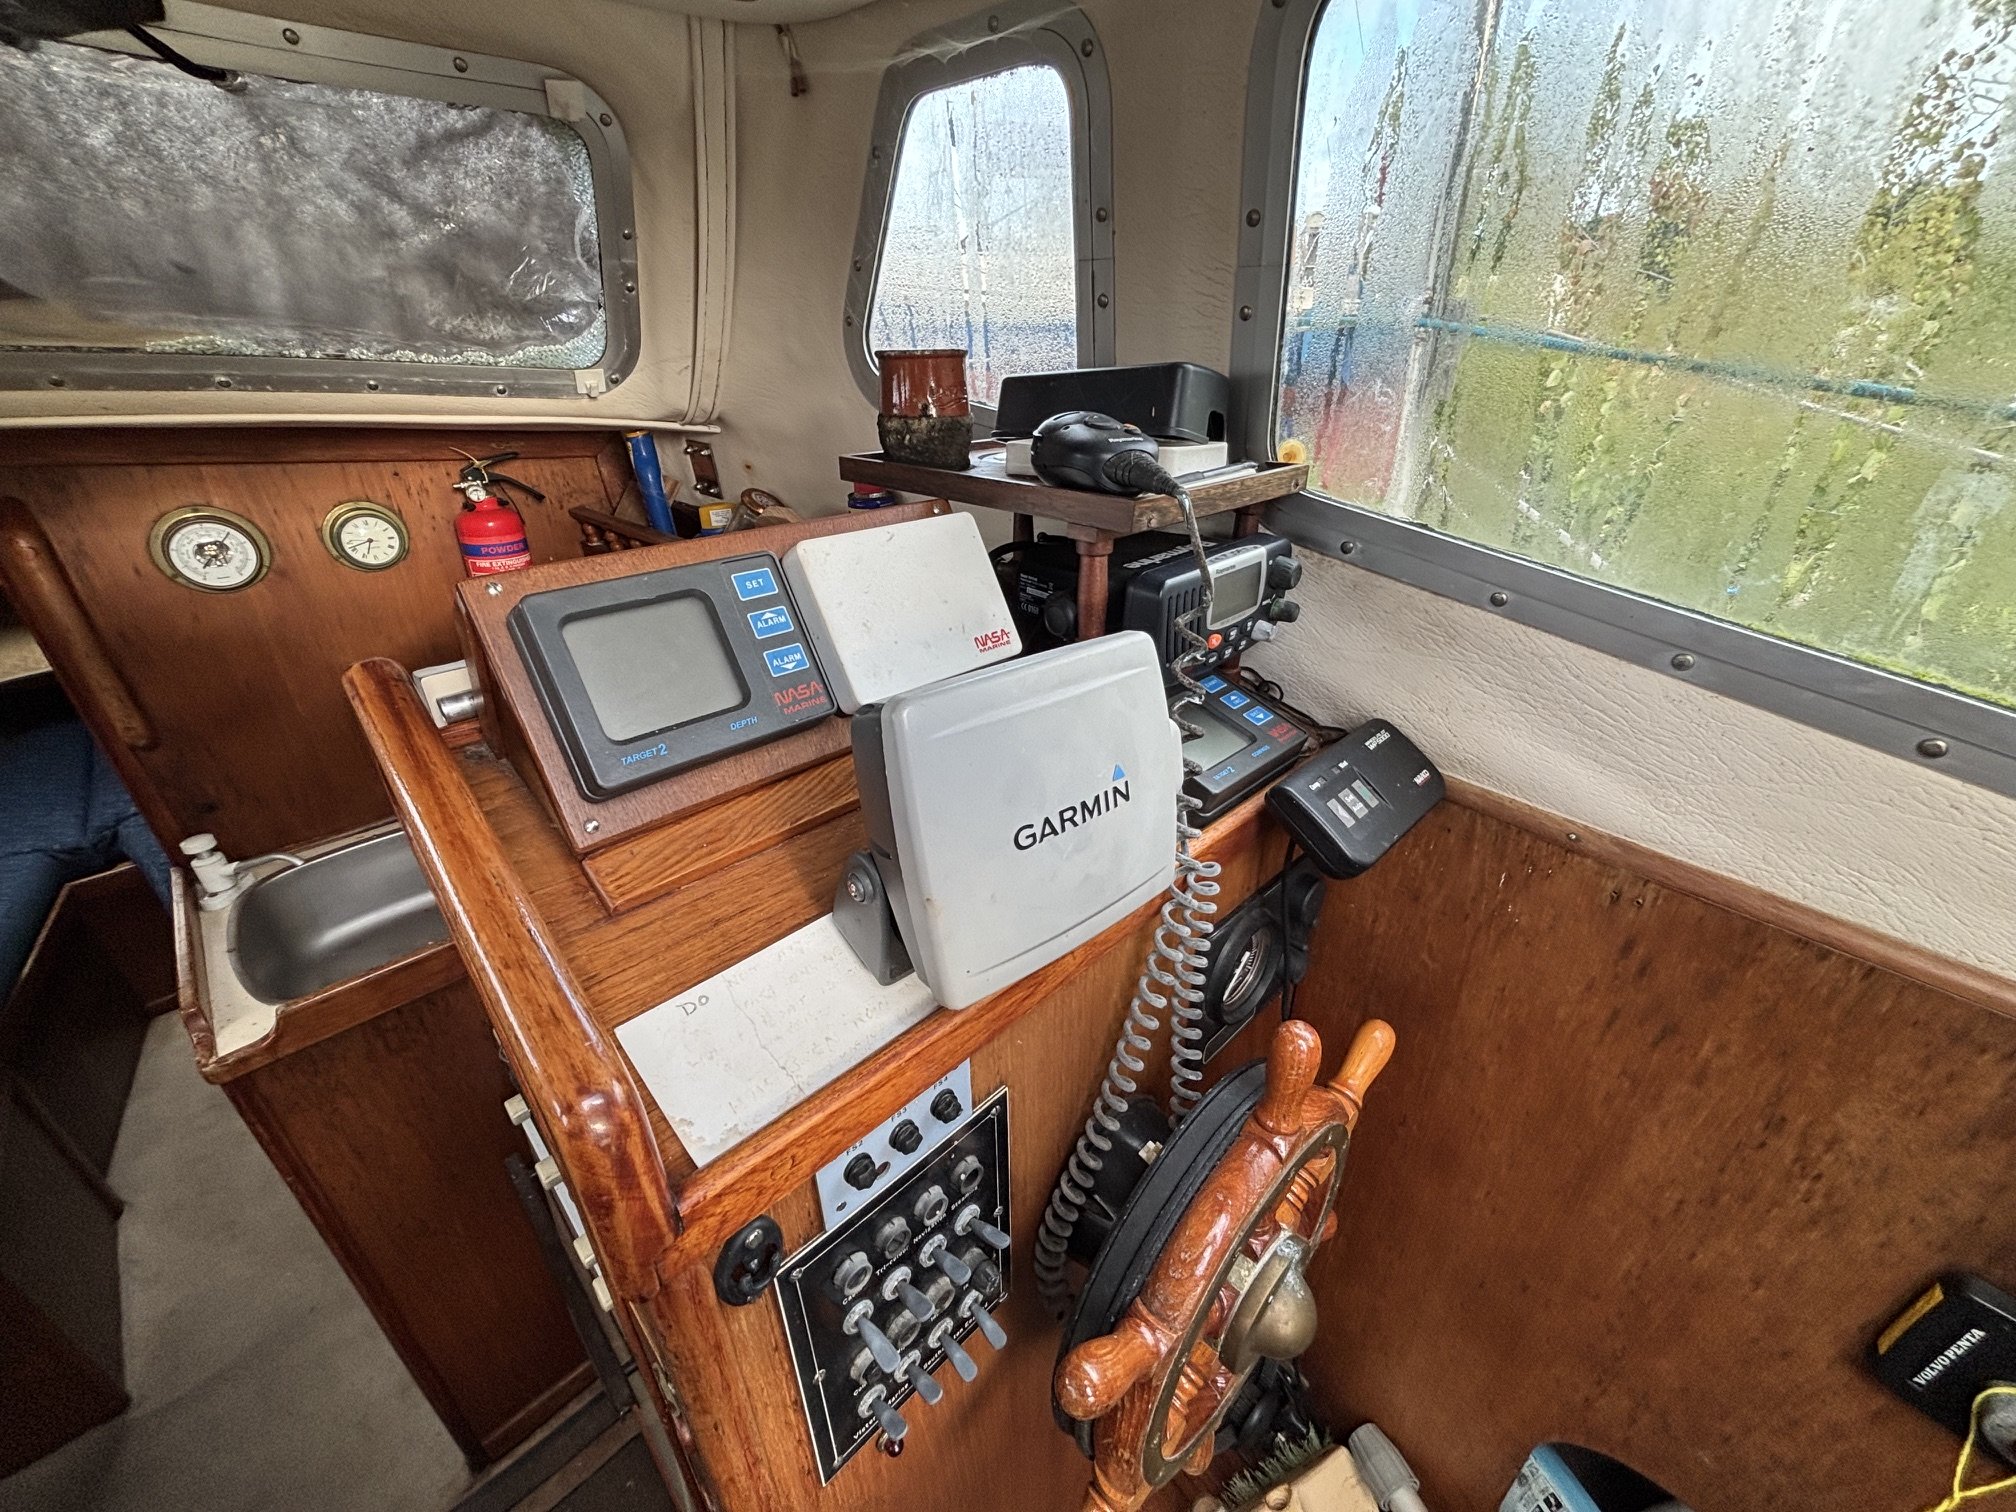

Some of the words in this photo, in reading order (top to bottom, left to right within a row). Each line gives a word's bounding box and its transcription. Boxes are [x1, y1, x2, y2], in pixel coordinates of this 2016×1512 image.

[480, 543, 525, 555] POWDER
[476, 560, 491, 568] FIRE
[745, 578, 764, 590] SET
[757, 616, 787, 630] ALARM
[974, 628, 1011, 649] NASA
[980, 641, 1011, 653] MARINE
[773, 652, 802, 667] ALARM
[773, 681, 824, 706] NASA
[783, 695, 827, 715] MARINE
[730, 716, 758, 731] DEPTH
[621, 747, 658, 766] TARGET
[658, 743, 669, 756] 2
[1014, 780, 1130, 850] GARMIN
[676, 994, 710, 1017] DO
[932, 1076, 949, 1090] FS4
[891, 1107, 907, 1122] FS3
[846, 1140, 863, 1156] FS2
[1912, 1355, 1950, 1386] VOLVO
[1943, 1328, 1986, 1360] PENTA
